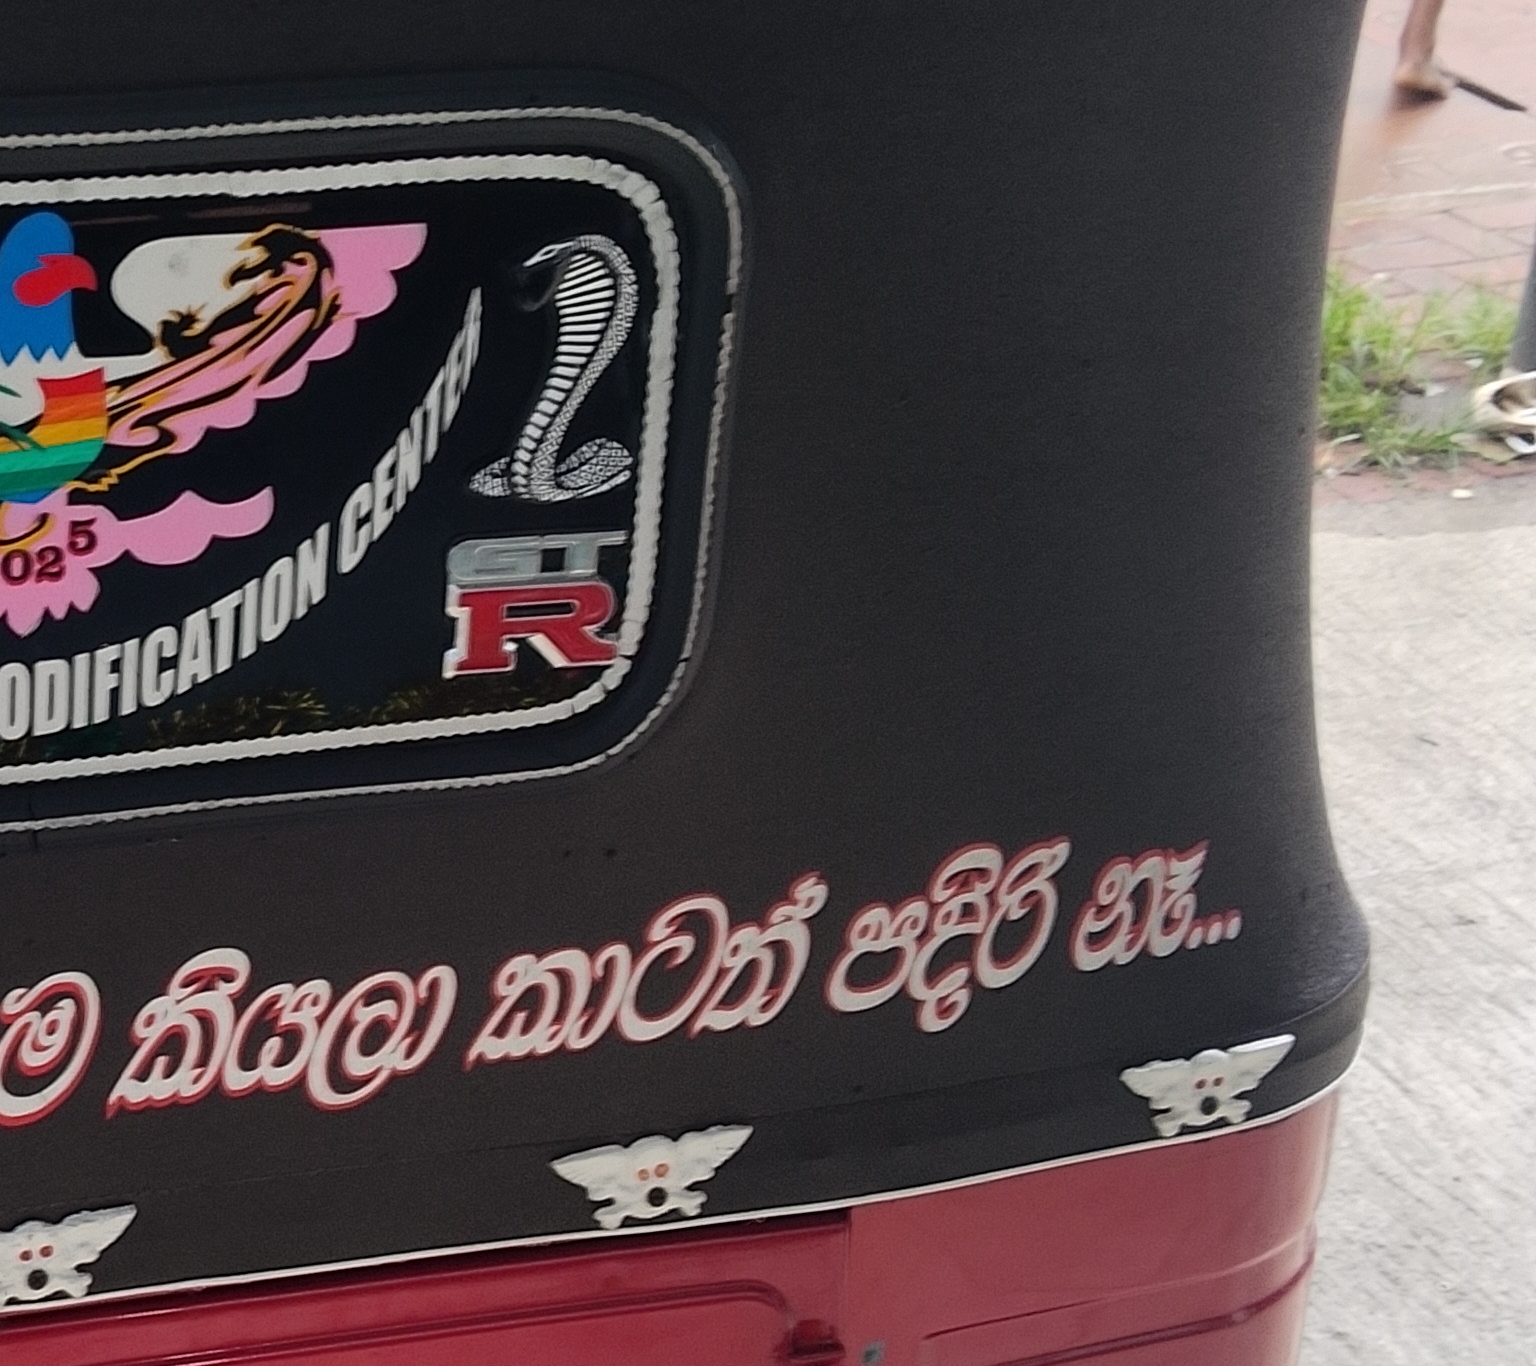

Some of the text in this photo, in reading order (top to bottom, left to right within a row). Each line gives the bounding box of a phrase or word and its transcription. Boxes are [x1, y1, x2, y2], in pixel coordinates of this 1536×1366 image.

[336, 286, 483, 575] CENTER
[443, 580, 619, 680] R
[446, 529, 630, 585] GT
[106, 947, 459, 1118] කියලා
[465, 871, 831, 1071] කාටත්
